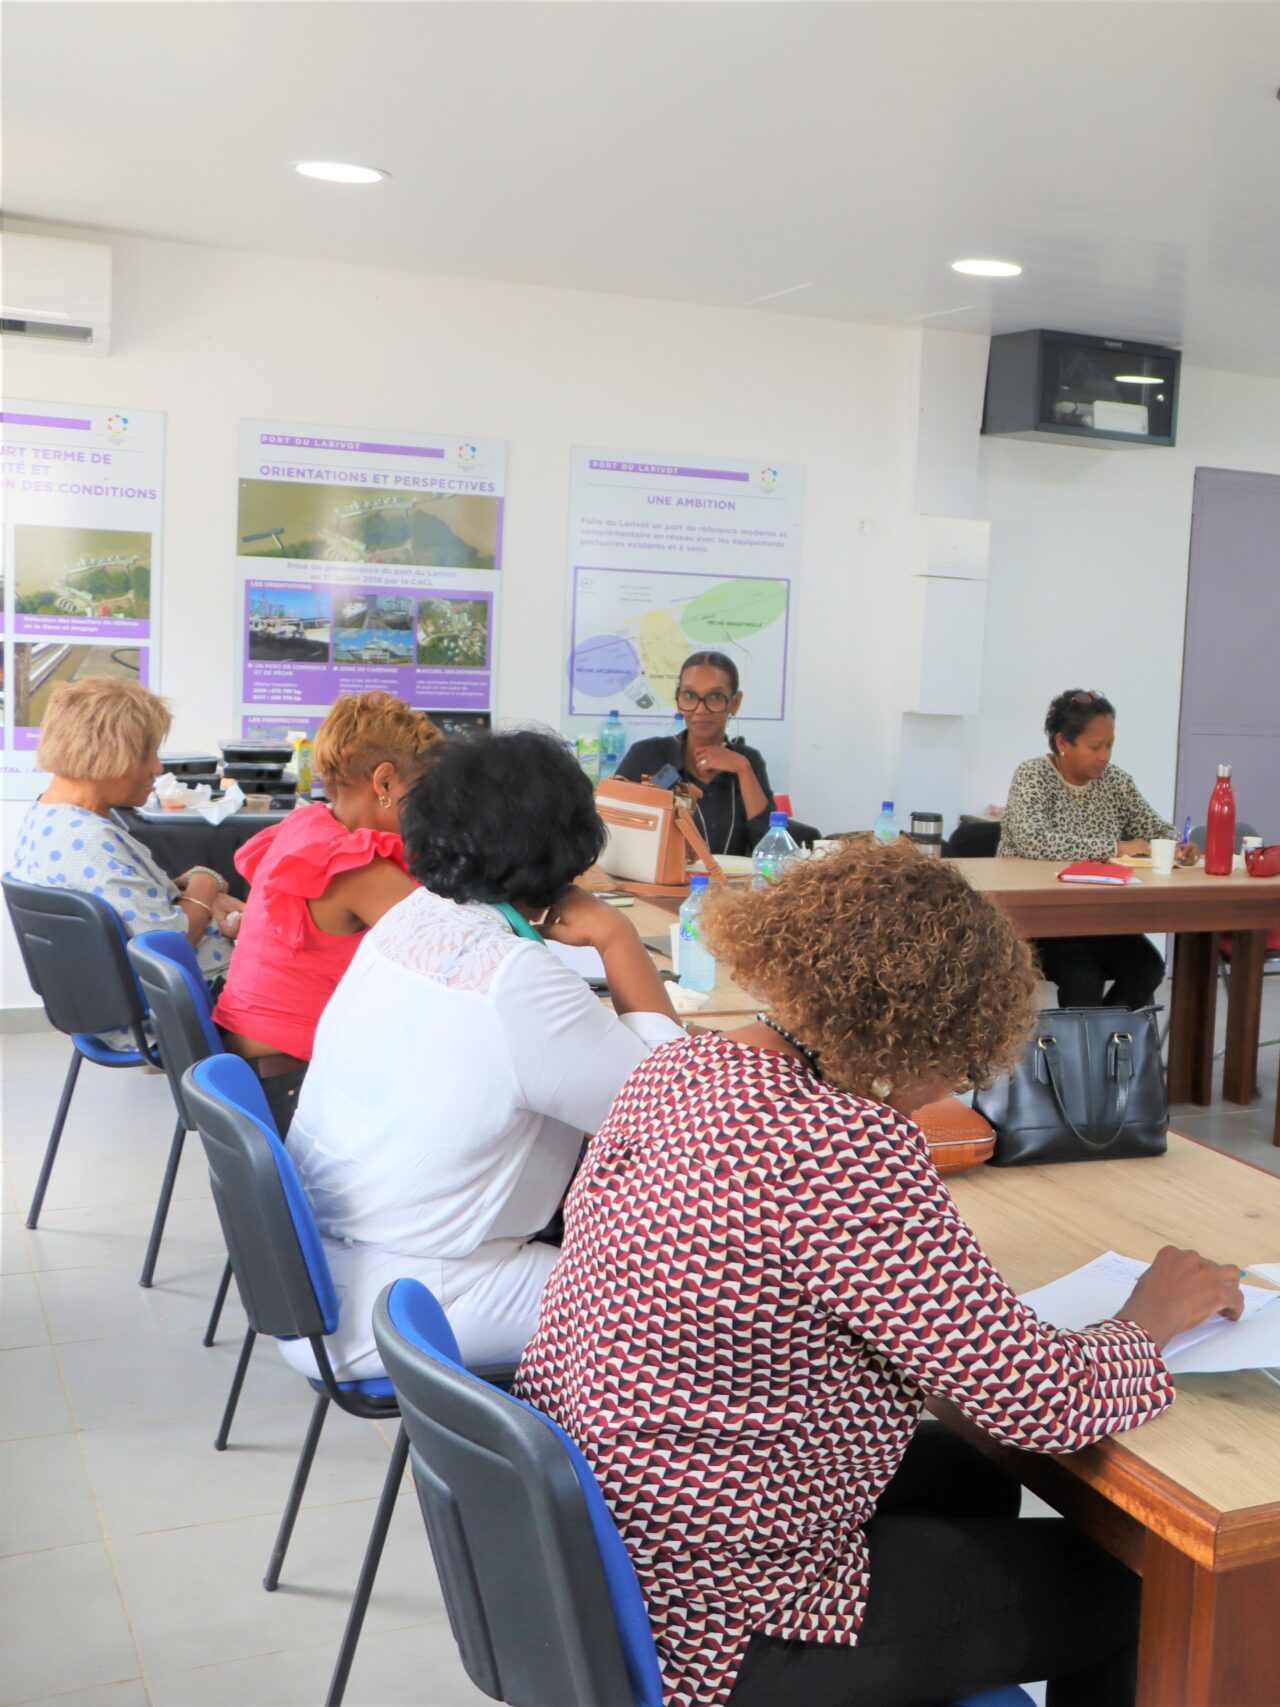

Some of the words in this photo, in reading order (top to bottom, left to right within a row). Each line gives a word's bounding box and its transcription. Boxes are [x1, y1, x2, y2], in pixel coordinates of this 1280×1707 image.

[262, 435, 290, 445] PORT
[295, 438, 310, 446] DU
[314, 439, 361, 450] LARIVOT
[32, 447, 87, 463] TERME
[90, 452, 113, 465] DE
[31, 464, 51, 476] ET
[592, 460, 617, 470] PORT
[621, 463, 635, 471] DU
[638, 464, 680, 475] LARIVOT
[259, 465, 368, 483] ORIENTATIONS
[372, 473, 390, 485] ET
[393, 475, 496, 492] PERSPECTIVES
[22, 480, 53, 493] DES
[58, 482, 158, 500] CONDITIONS
[646, 494, 673, 506] UNE
[675, 496, 736, 511] AMBITION
[606, 518, 617, 526] du
[619, 519, 649, 529] Larivot
[665, 522, 683, 531] port
